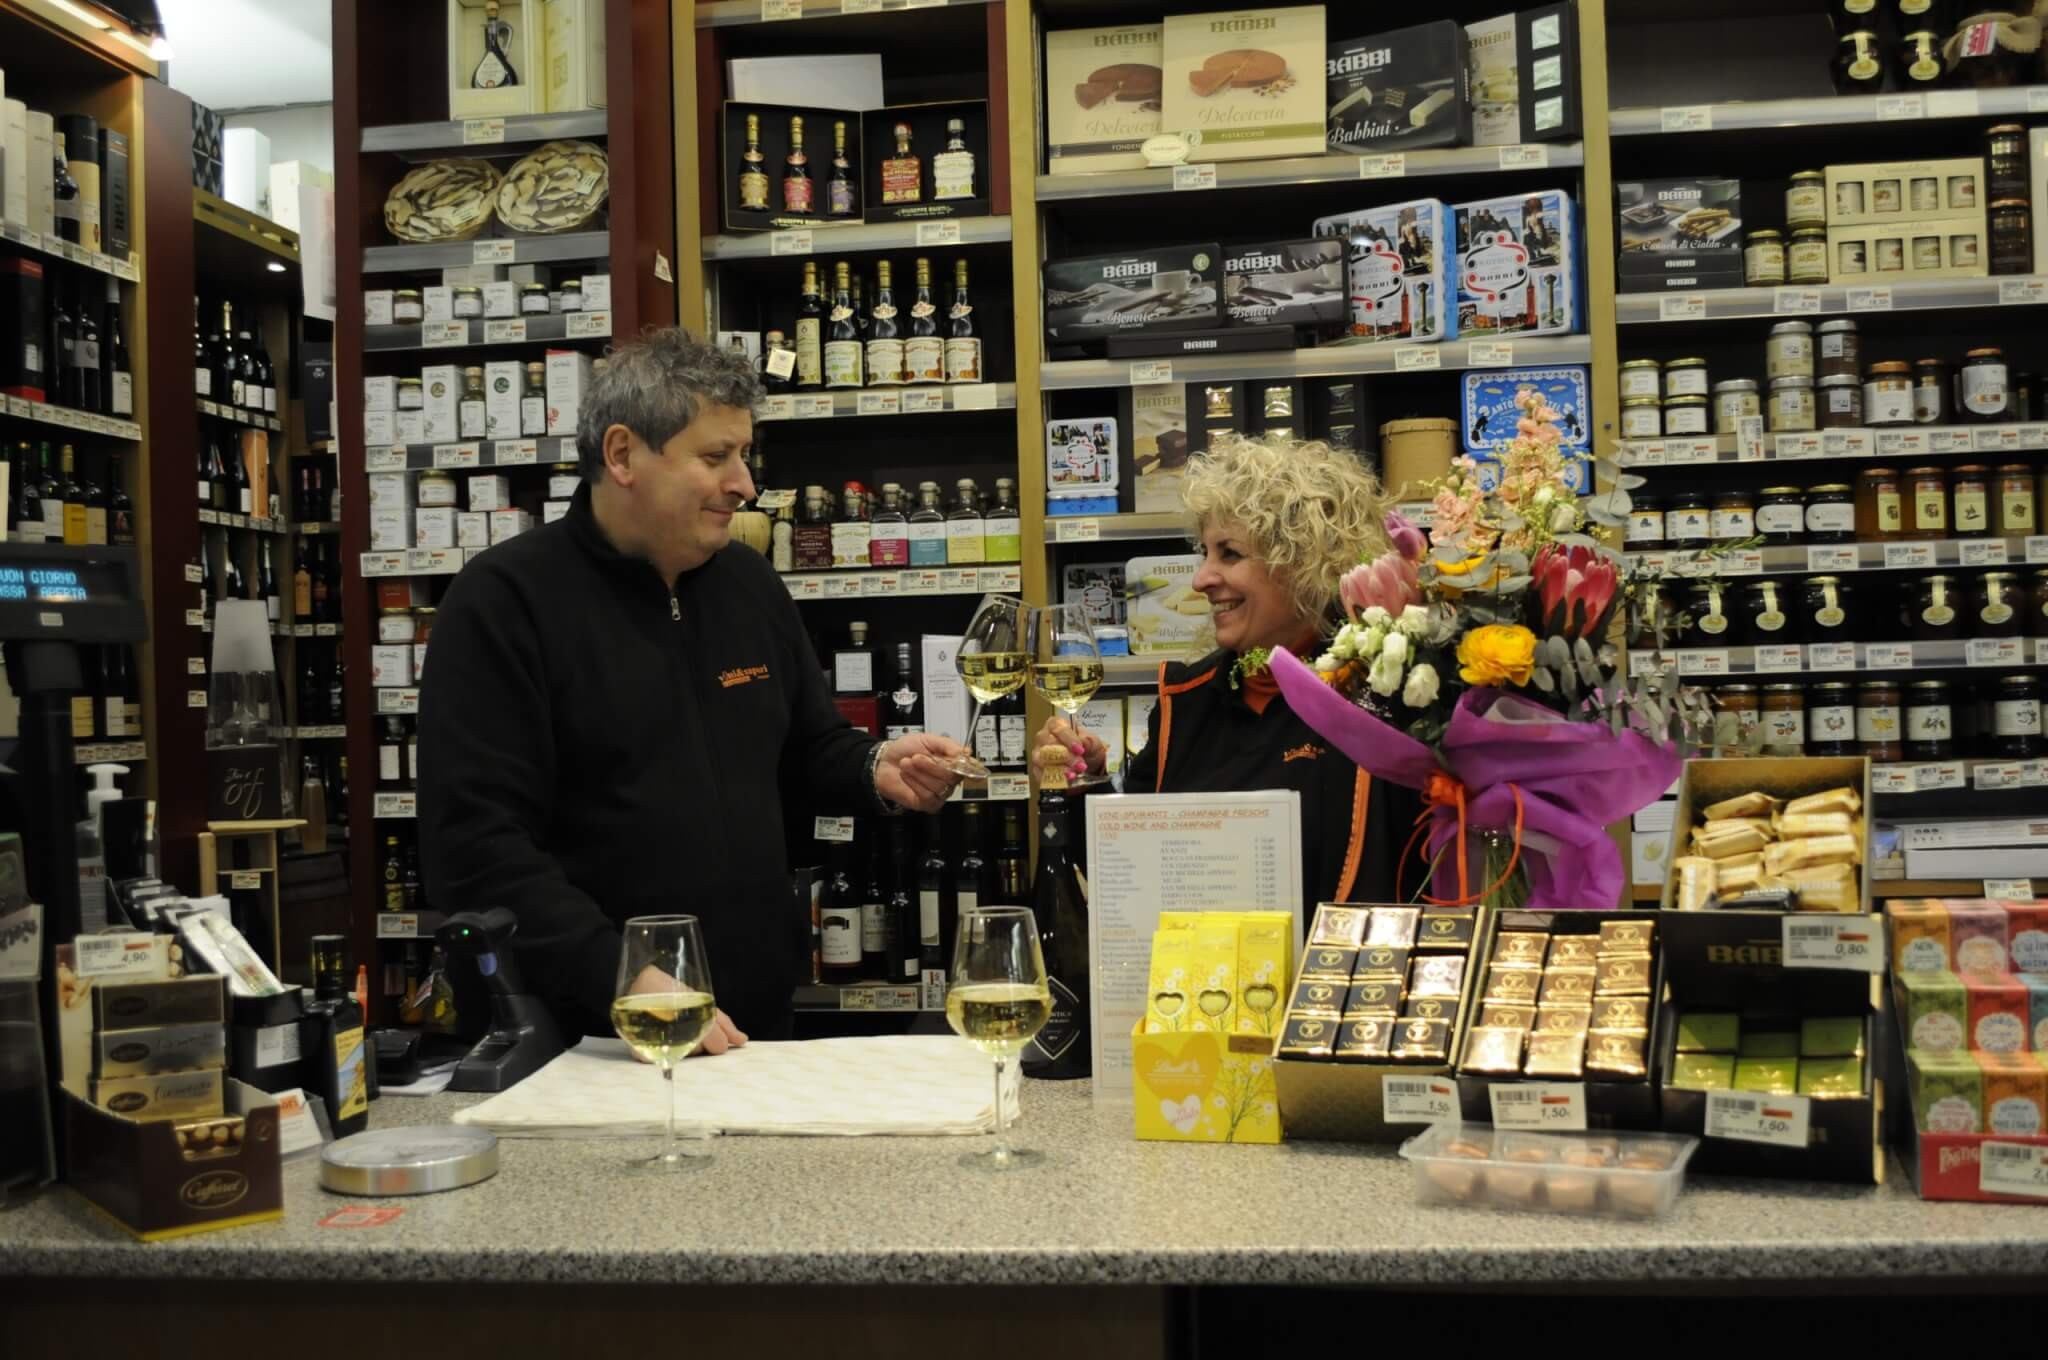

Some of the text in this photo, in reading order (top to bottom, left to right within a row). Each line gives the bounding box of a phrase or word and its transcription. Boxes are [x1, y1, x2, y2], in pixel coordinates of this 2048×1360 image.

[1210, 17, 1276, 33] BABBI
[1094, 31, 1158, 47] BABBI
[1327, 119, 1392, 144] Babbini
[1103, 261, 1158, 279] BABBI
[1226, 254, 1283, 272] BABBI
[30, 569, 77, 585] GIORNO
[40, 586, 87, 601] APERTA
[1707, 944, 1782, 963] BAB
